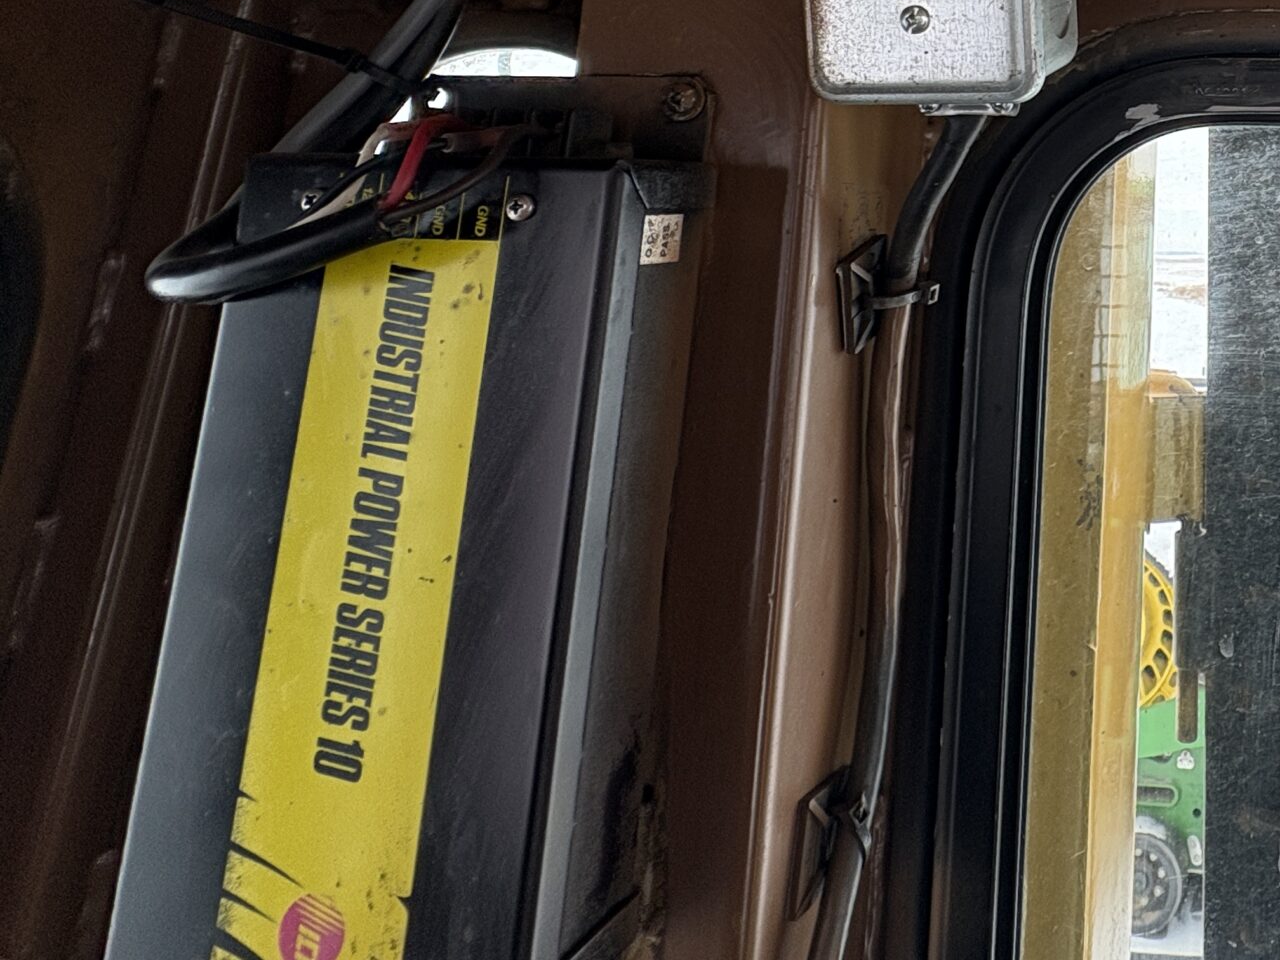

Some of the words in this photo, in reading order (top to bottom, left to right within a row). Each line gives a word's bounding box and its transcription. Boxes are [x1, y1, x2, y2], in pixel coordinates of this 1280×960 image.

[431, 205, 447, 236] GND
[474, 205, 489, 237] GND
[360, 264, 435, 461] INDUSTRIAL
[340, 467, 405, 601] POWER
[321, 602, 385, 732] SERIES
[313, 736, 365, 783] 10
